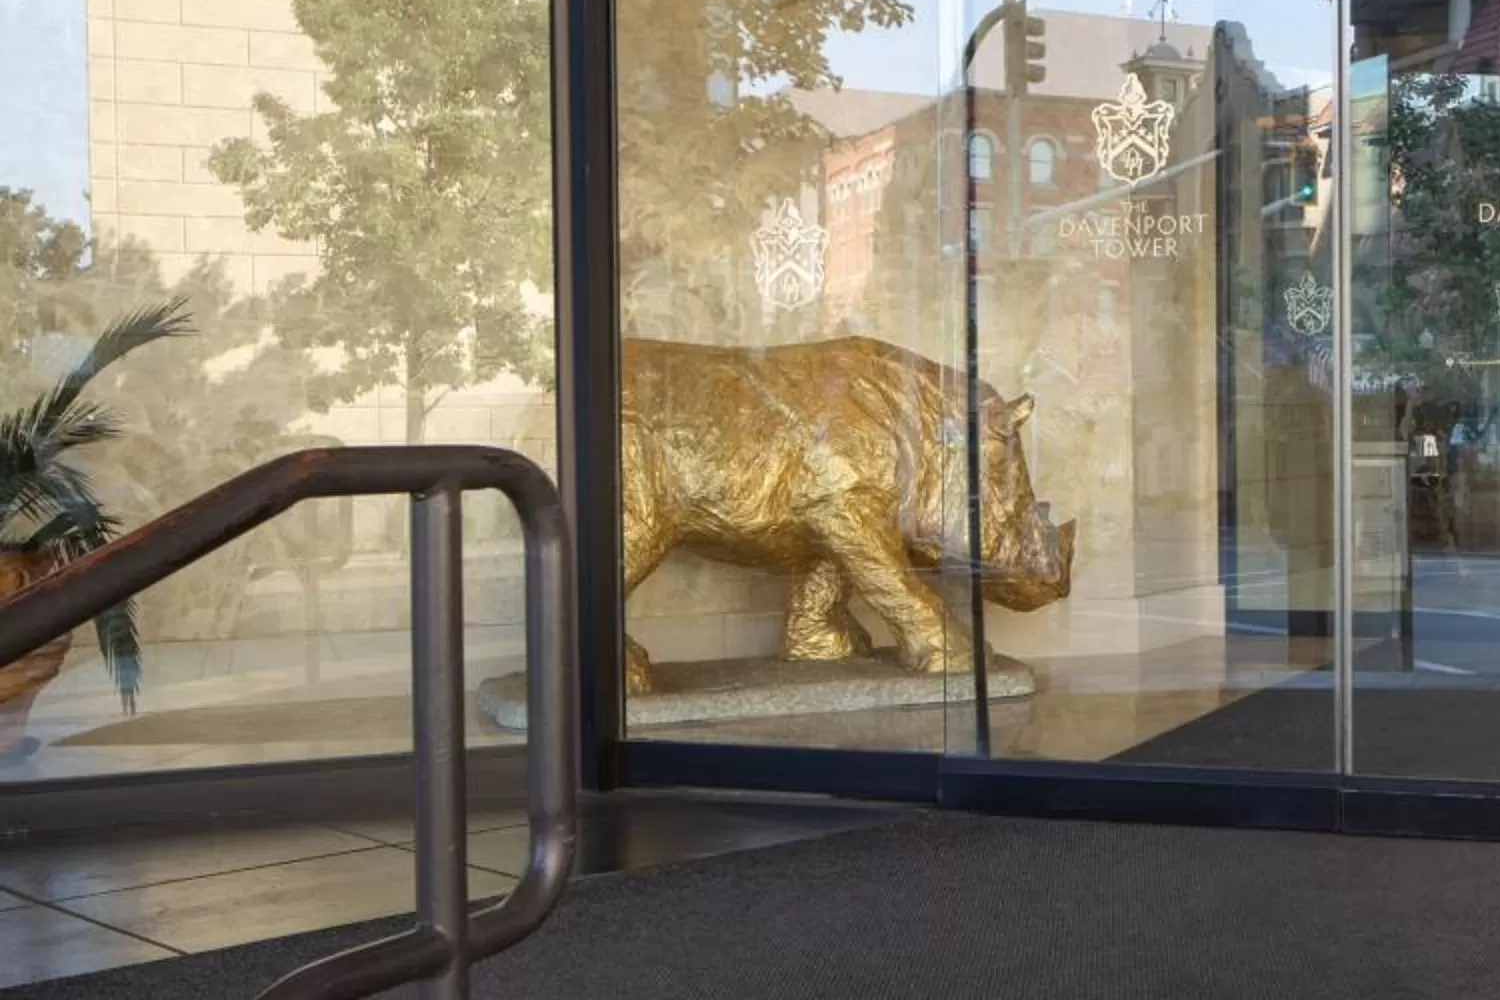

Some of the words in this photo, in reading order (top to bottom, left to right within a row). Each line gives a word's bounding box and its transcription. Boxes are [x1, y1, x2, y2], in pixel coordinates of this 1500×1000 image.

[1120, 201, 1151, 213] THE
[1059, 213, 1210, 237] DAVENPORT
[1088, 238, 1179, 260] TOWER
